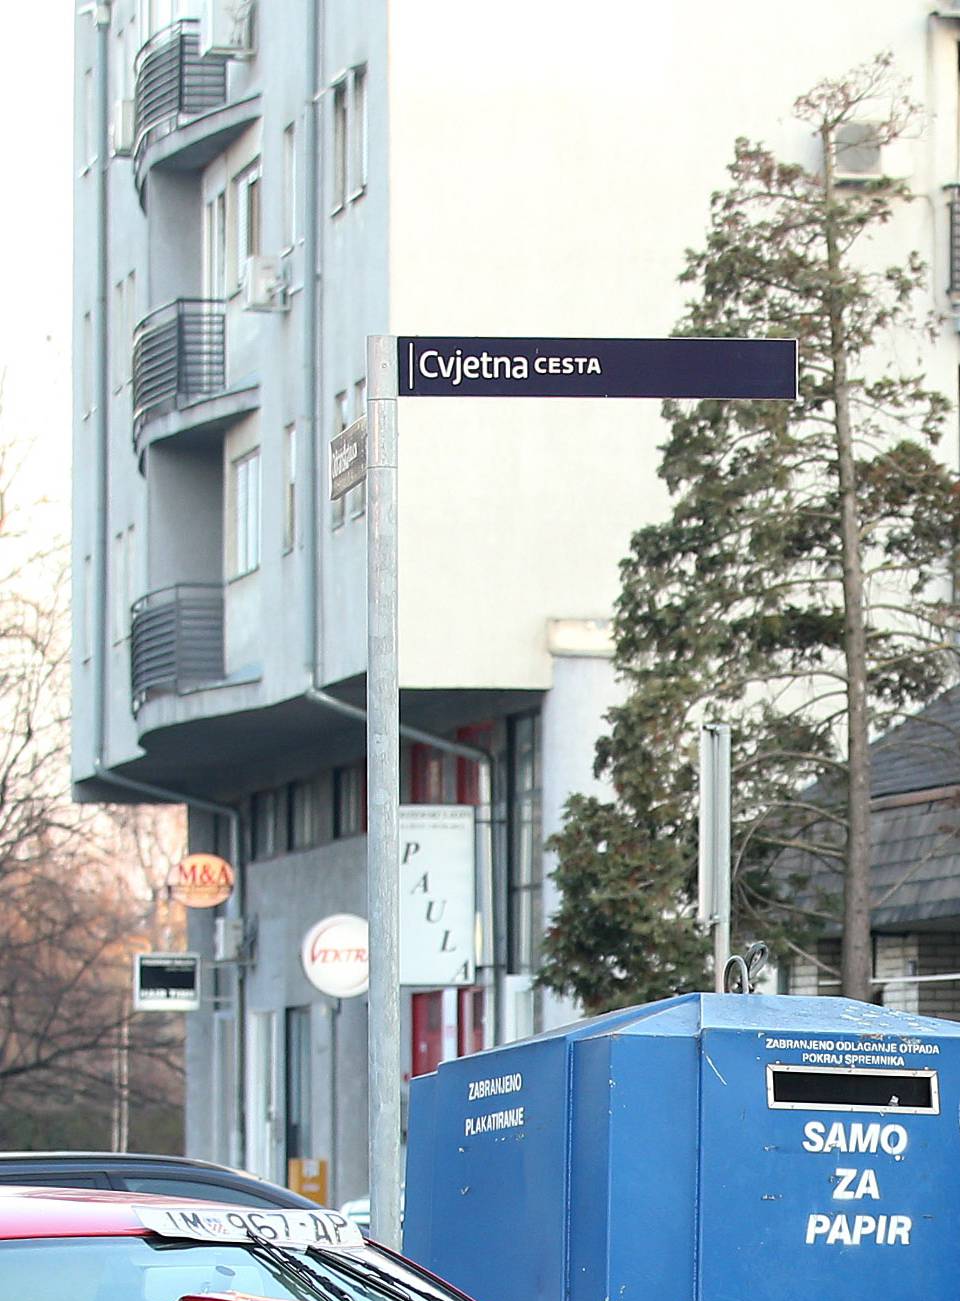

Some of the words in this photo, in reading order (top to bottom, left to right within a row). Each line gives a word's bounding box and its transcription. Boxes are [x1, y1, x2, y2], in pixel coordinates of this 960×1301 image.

[419, 349, 529, 385] Cvjetna
[534, 356, 602, 375] CESTA
[179, 863, 230, 886] M&A
[310, 944, 368, 965] VEKTR
[766, 1037, 835, 1051] ZABRANJENO
[835, 1040, 896, 1054] ODLAGANJE
[901, 1043, 940, 1055] OTPADA
[802, 1053, 843, 1065] POKRAJ
[844, 1054, 905, 1067] SPREMNIKA
[468, 1073, 523, 1101] ZABRANJENO
[465, 1107, 525, 1137] PLAKATIRANJE
[802, 1120, 909, 1156] SAMO
[832, 1167, 881, 1201] ZA
[226, 1212, 348, 1246] 967-AP
[805, 1213, 913, 1246] PAPIR
